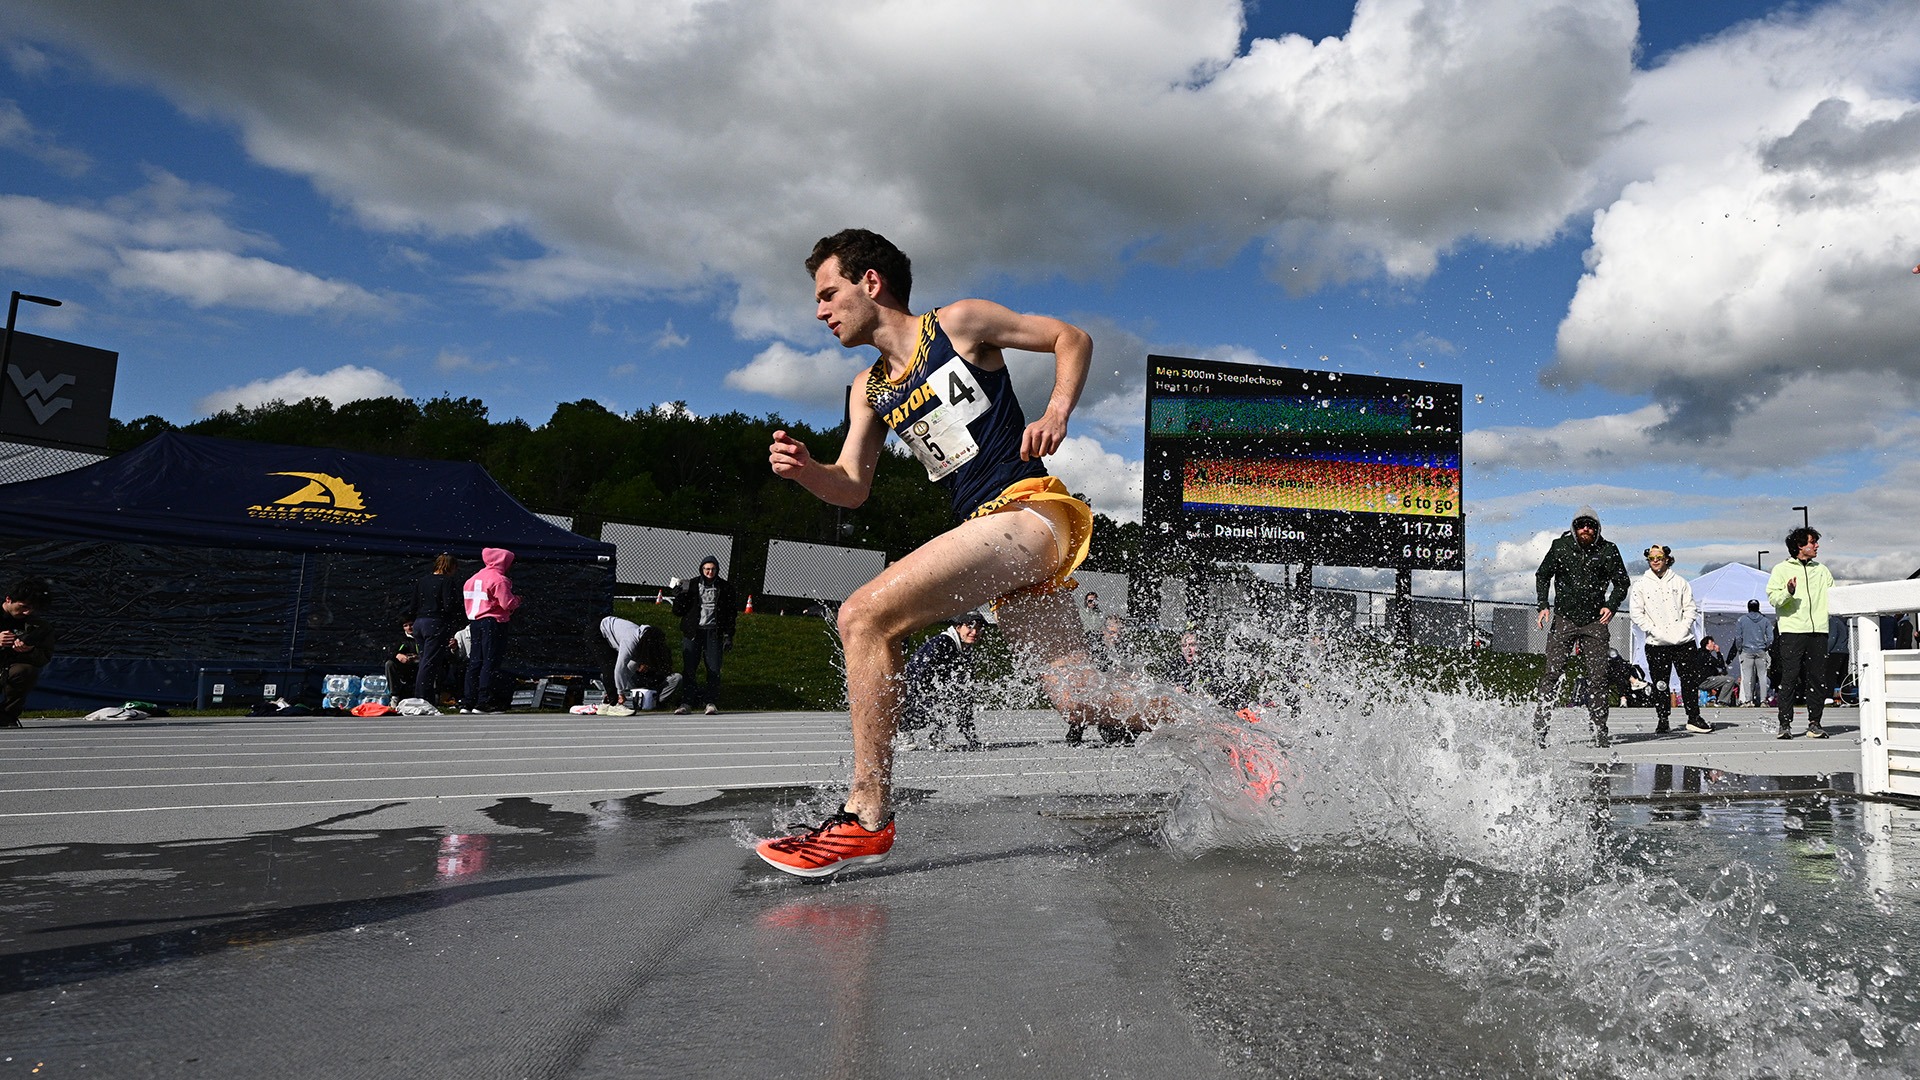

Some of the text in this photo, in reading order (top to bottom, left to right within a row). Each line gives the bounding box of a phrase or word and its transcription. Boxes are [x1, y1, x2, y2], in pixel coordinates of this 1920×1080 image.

[1156, 366, 1282, 387] Men 3000m Steeplechase
[949, 371, 976, 406] 4
[1155, 381, 1210, 394] Heat 1 of 1
[921, 433, 945, 461] 5
[1163, 469, 1171, 481] 8
[246, 505, 378, 519] ALLEGHENY
[1403, 495, 1453, 514] 6 to go
[1215, 524, 1257, 539] Daniel
[1260, 526, 1306, 540] Wilson
[1402, 521, 1453, 537] 1:17.78
[1403, 544, 1453, 563] 6 to go
